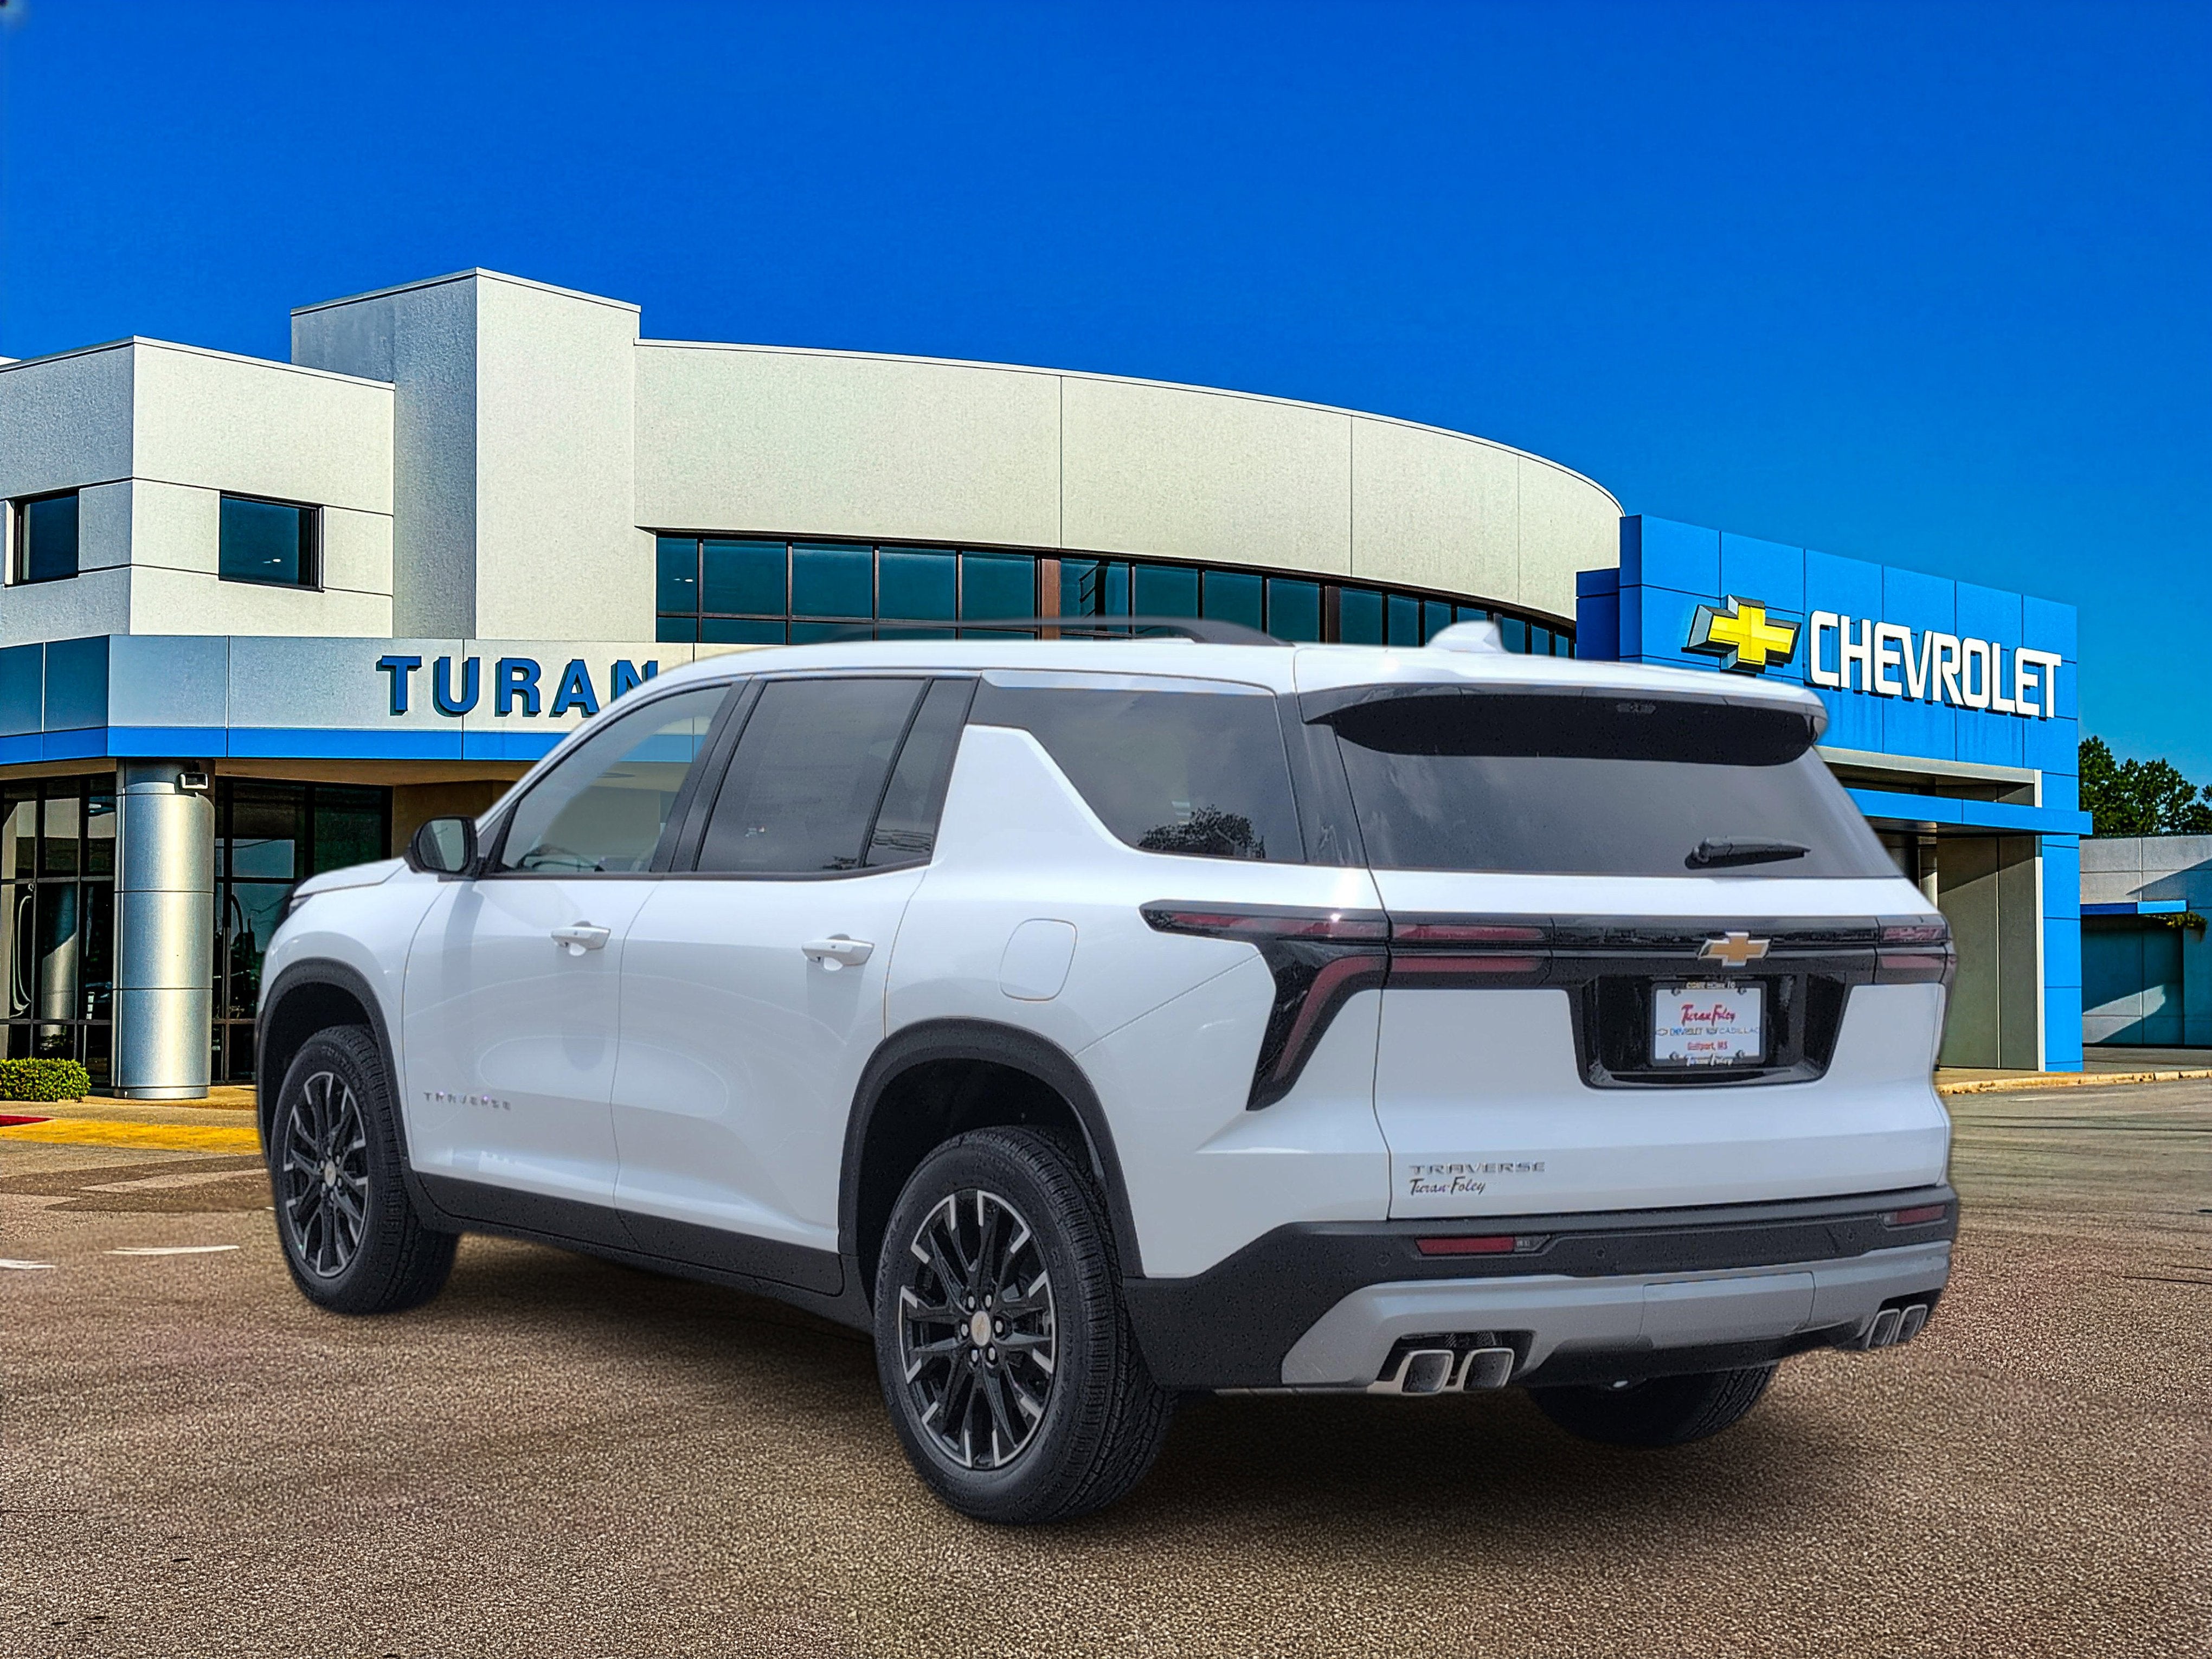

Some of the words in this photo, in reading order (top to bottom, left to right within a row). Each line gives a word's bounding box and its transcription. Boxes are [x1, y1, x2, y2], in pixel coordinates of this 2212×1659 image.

[1810, 609, 2062, 719] CHEVROLET
[376, 655, 658, 717] TURAN
[1681, 1004, 1712, 1026] Turan
[1410, 1161, 1545, 1175] TRAVERSE
[1410, 1178, 1448, 1195] Turan
[1450, 1176, 1486, 1195] Foley
